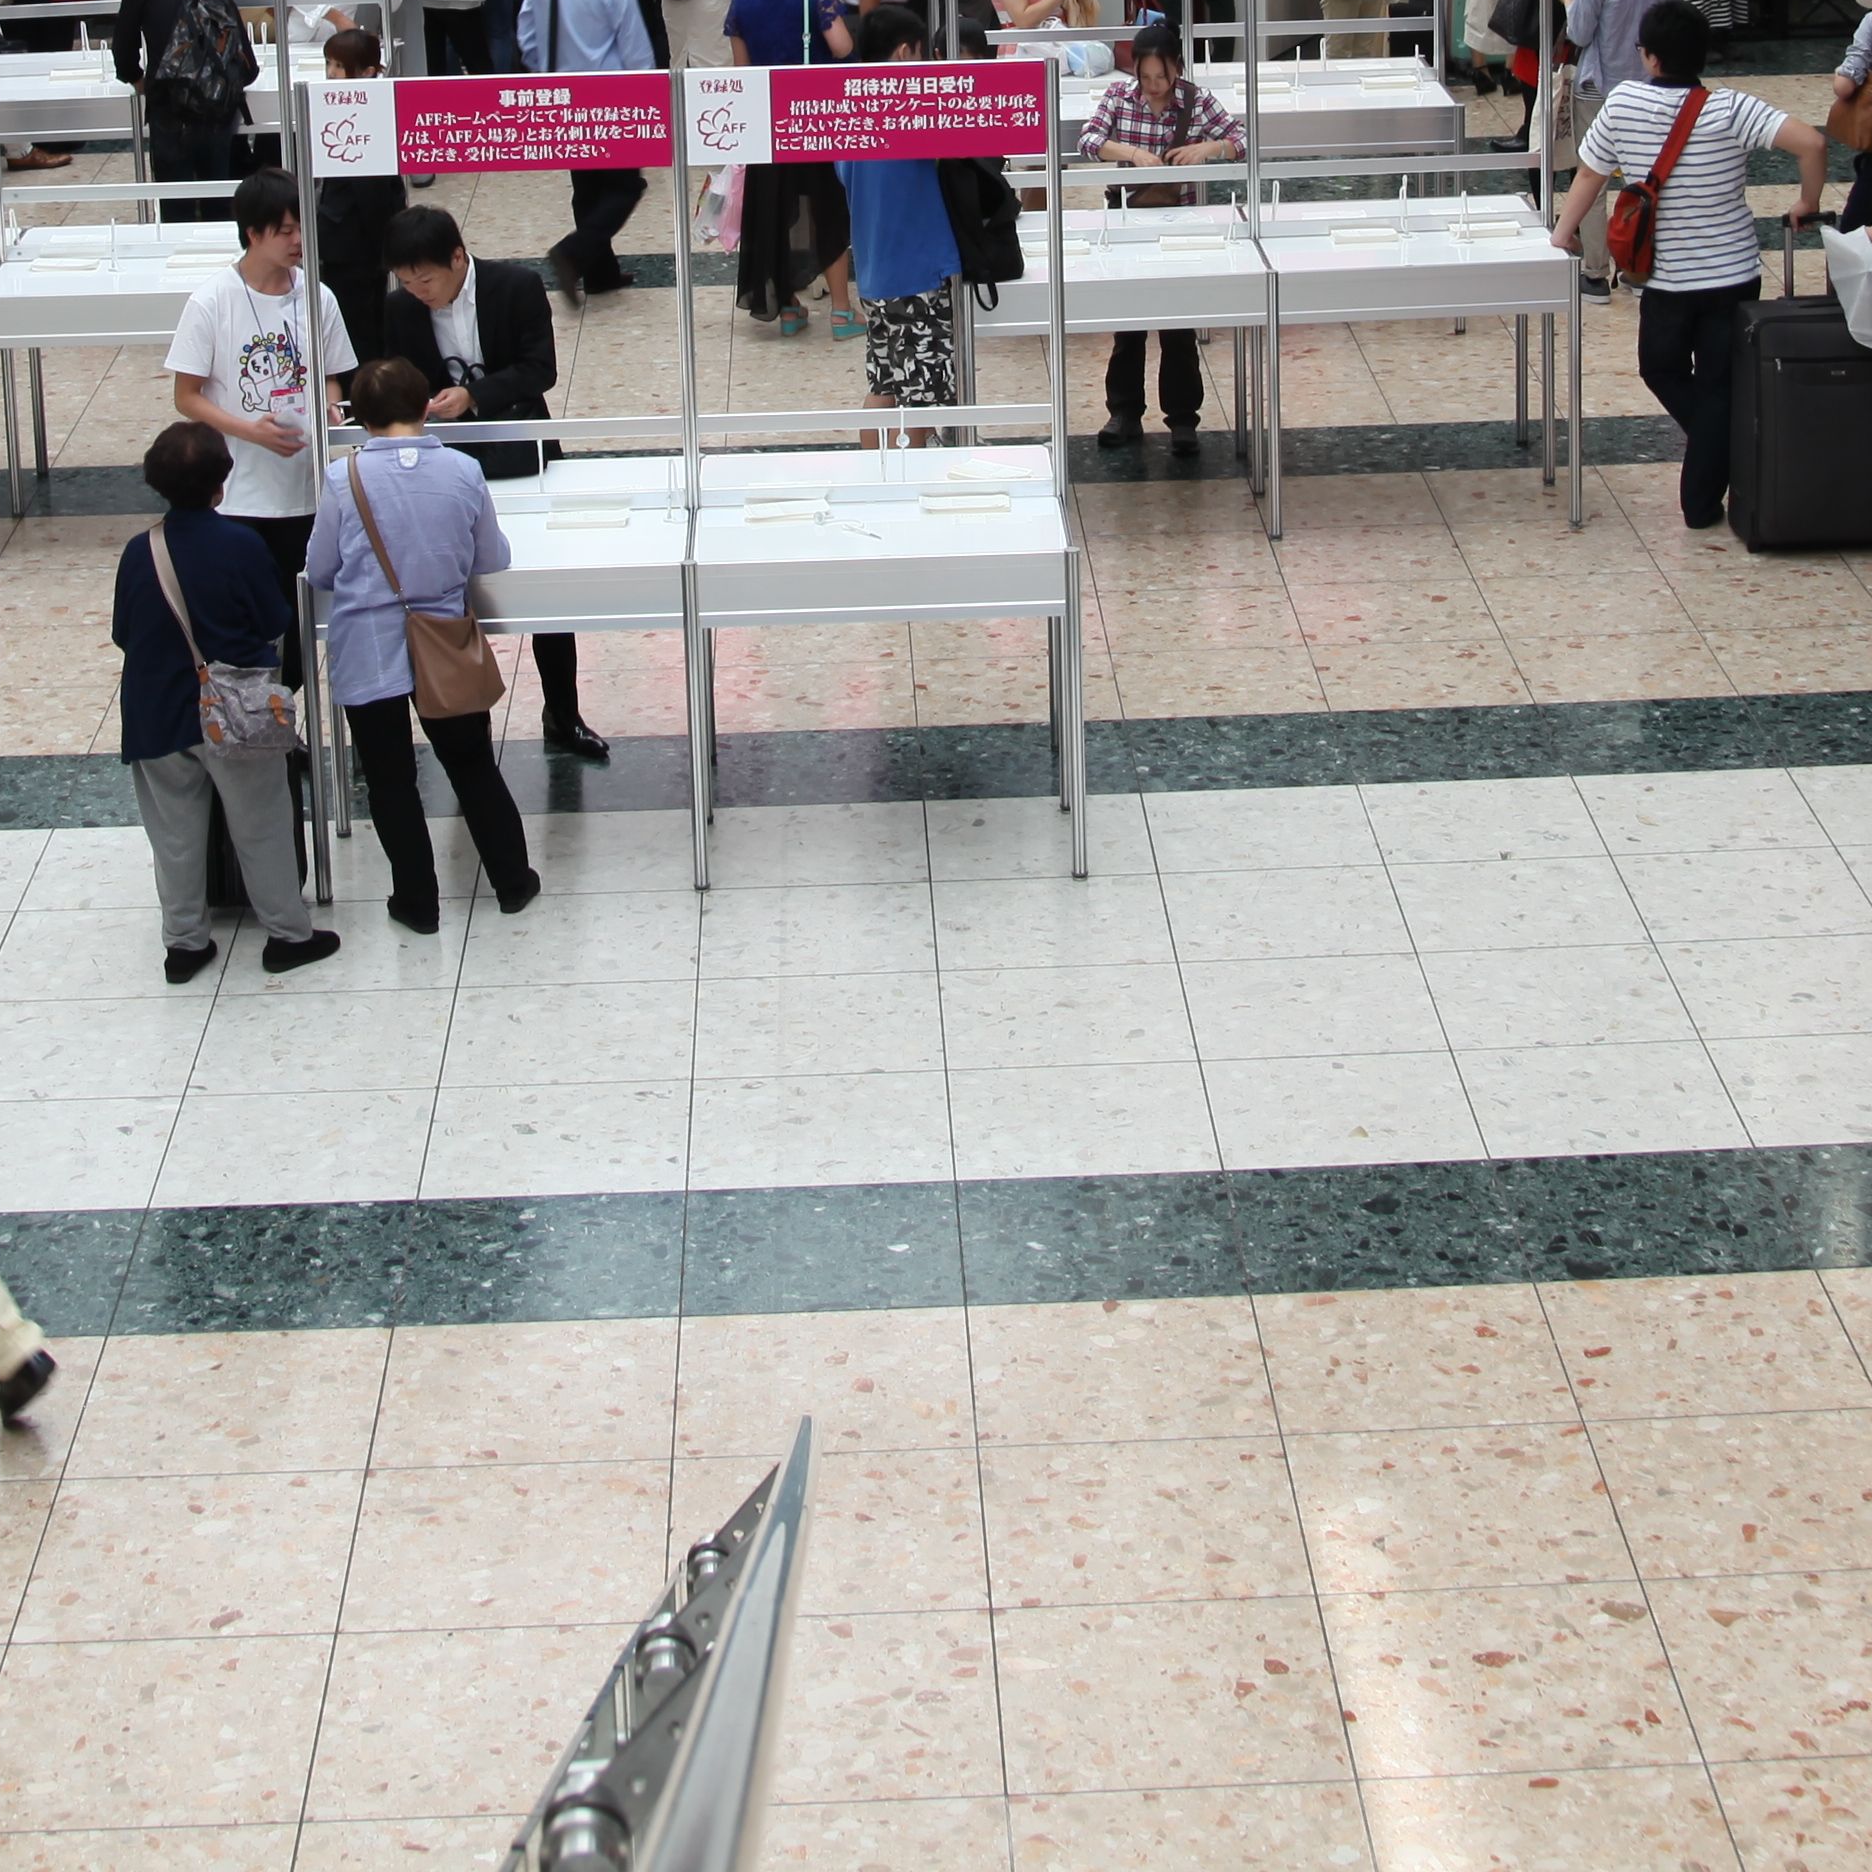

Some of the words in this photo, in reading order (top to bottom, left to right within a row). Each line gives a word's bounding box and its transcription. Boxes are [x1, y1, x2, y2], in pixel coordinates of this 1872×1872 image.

[843, 74, 974, 97] 招待状/当日受付
[498, 87, 571, 107] 事前登録
[720, 122, 747, 133] AFF
[345, 133, 371, 146] AFF
